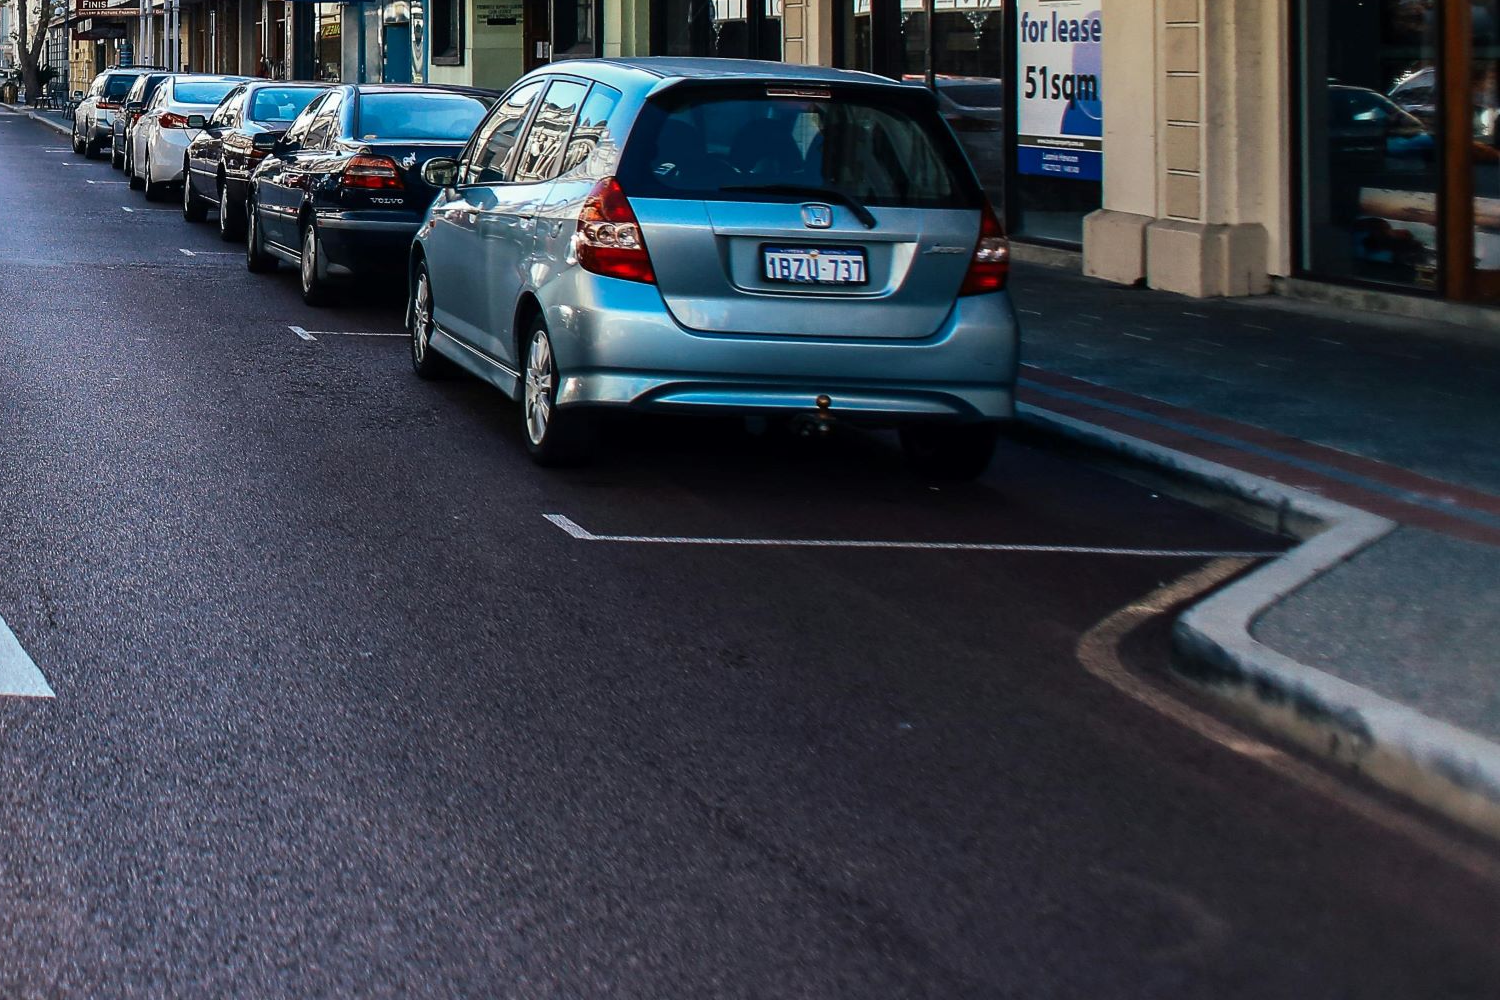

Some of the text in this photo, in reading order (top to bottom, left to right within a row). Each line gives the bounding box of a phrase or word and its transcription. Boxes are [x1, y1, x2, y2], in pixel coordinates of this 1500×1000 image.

[83, 0, 108, 9] FINIS
[1021, 11, 1101, 43] for lease
[1025, 65, 1098, 109] 51sqm
[370, 197, 404, 205] VOLVO
